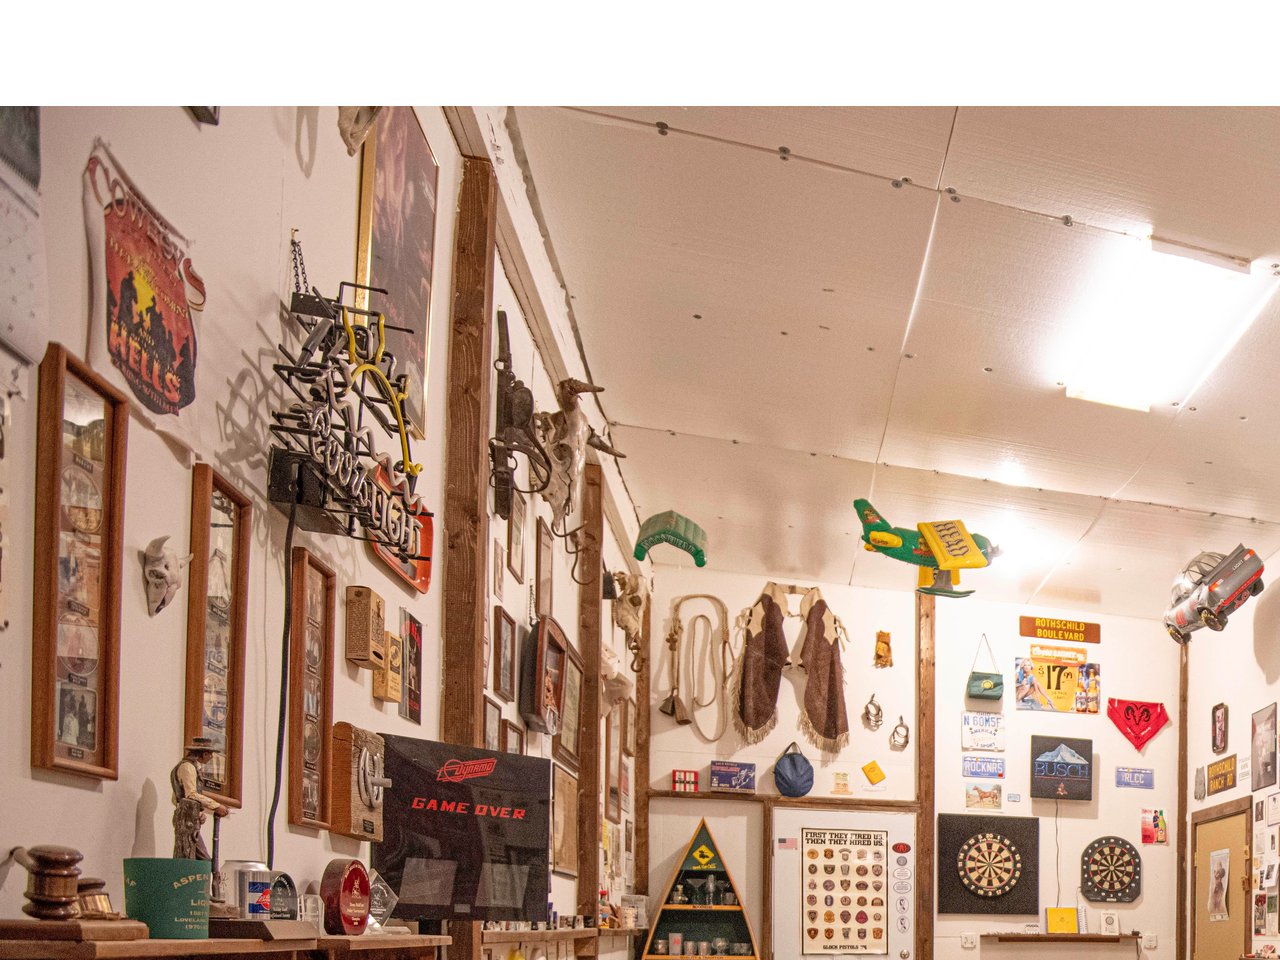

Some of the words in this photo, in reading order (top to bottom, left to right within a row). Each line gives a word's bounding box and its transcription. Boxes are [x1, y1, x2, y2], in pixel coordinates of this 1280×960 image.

[1035, 617, 1086, 632] ROTHSCHILD
[1036, 628, 1085, 642] BOULEVARD
[1046, 665, 1068, 691] 17
[964, 761, 1003, 774] ROCKNRS
[1034, 761, 1089, 778] BUSCH
[411, 796, 470, 814] GAME
[474, 804, 526, 820] OVER
[805, 831, 827, 839] FIRST
[828, 832, 849, 840] THEY
[828, 838, 848, 846] THEY
